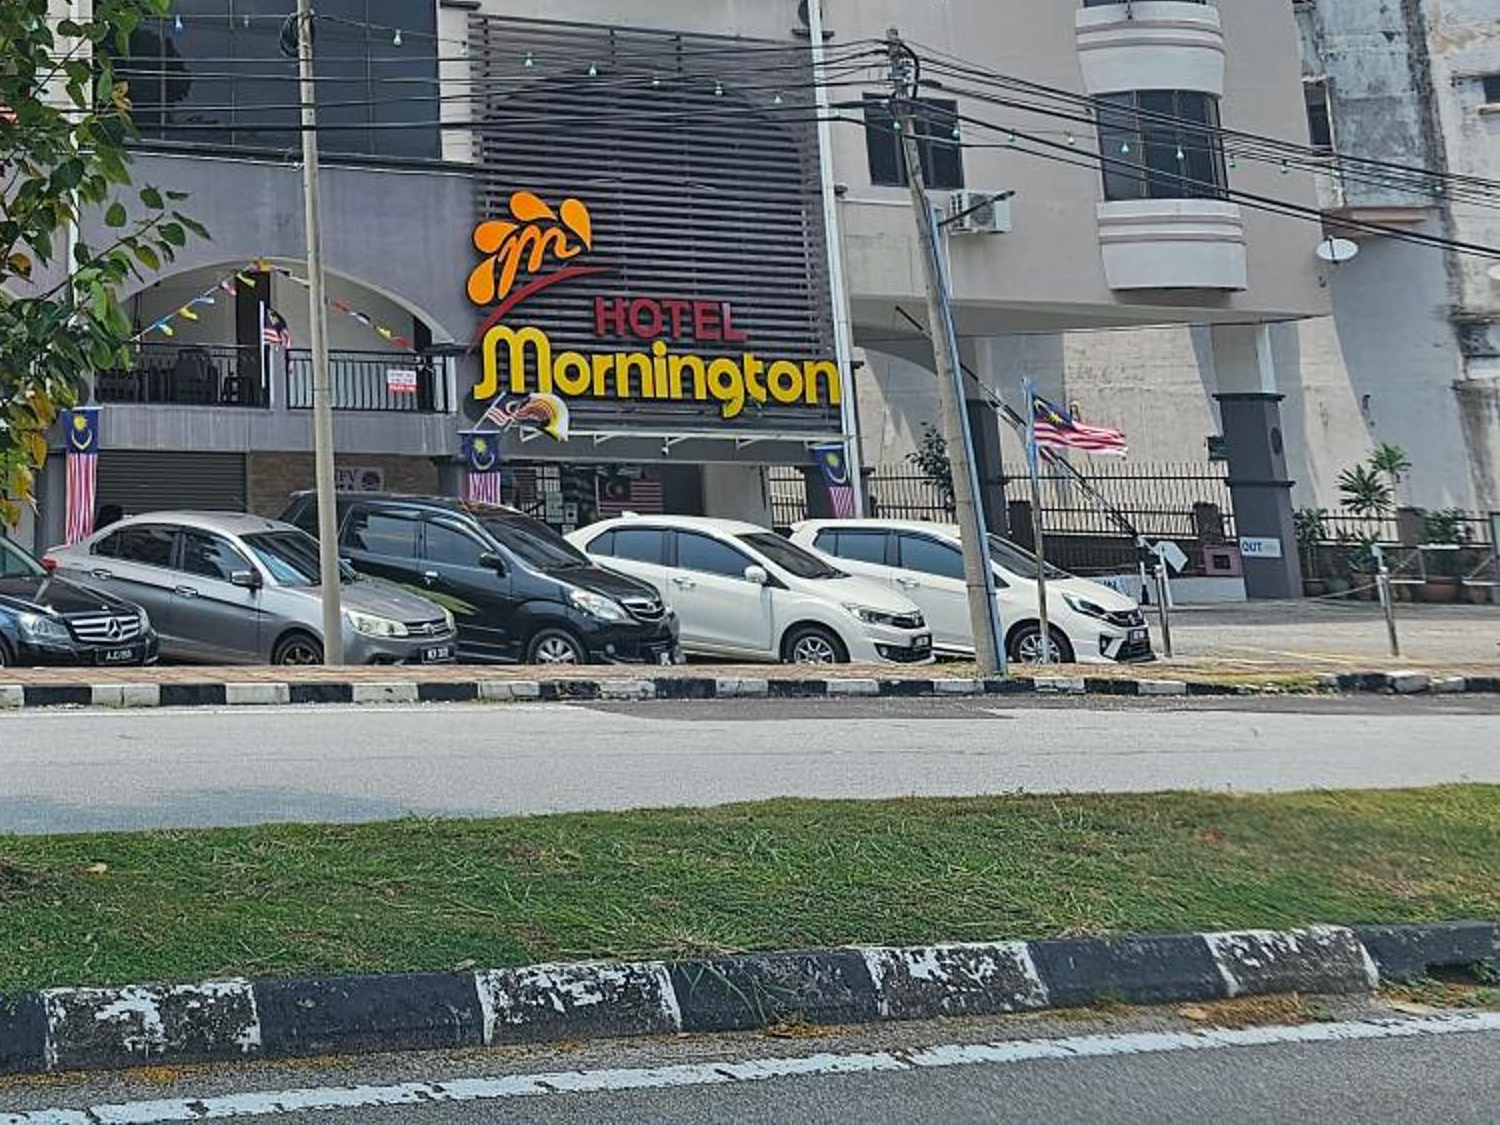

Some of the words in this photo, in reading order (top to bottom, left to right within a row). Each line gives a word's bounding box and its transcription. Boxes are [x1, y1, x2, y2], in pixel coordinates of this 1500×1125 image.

[594, 296, 748, 341] HOTEL
[473, 325, 842, 418] Mornington
[1242, 540, 1262, 552] OUT
